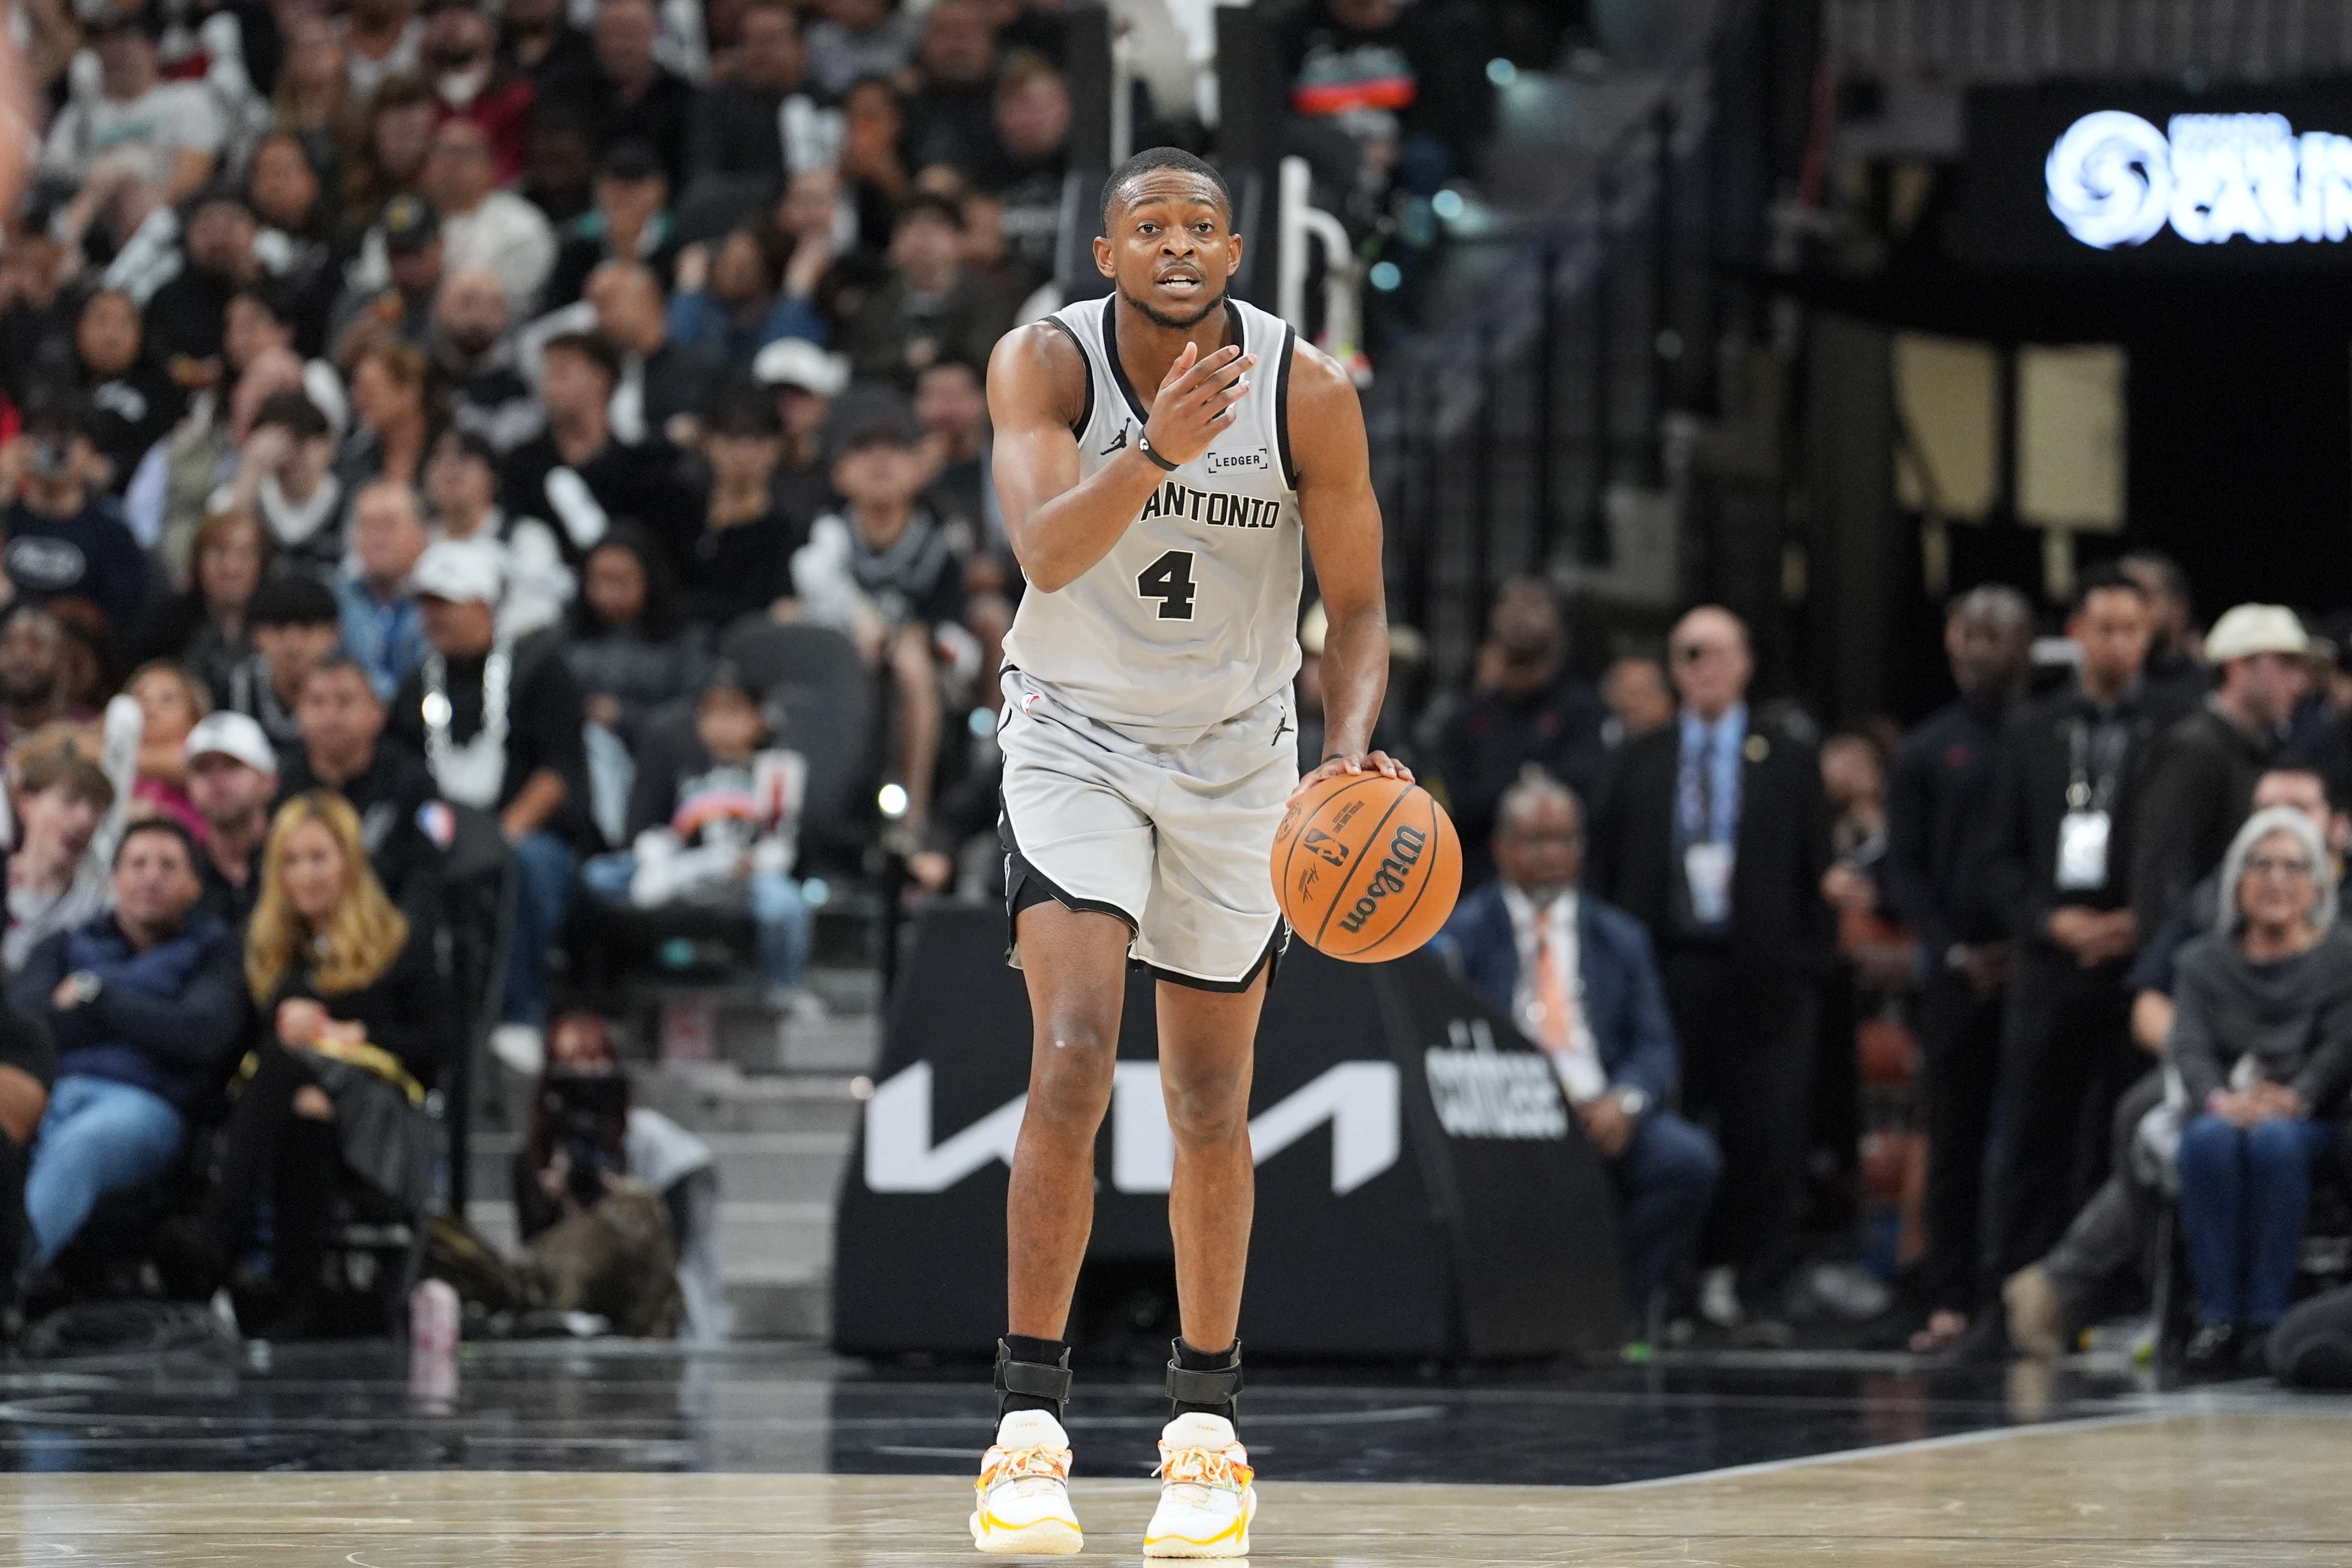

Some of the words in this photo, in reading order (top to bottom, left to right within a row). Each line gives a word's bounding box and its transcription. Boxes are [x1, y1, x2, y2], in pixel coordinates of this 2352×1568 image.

[1216, 455, 1261, 467] LEDGER
[1138, 479, 1281, 530] ANTONIO
[1135, 548, 1198, 622] 4
[1337, 824, 1426, 933] Wilson
